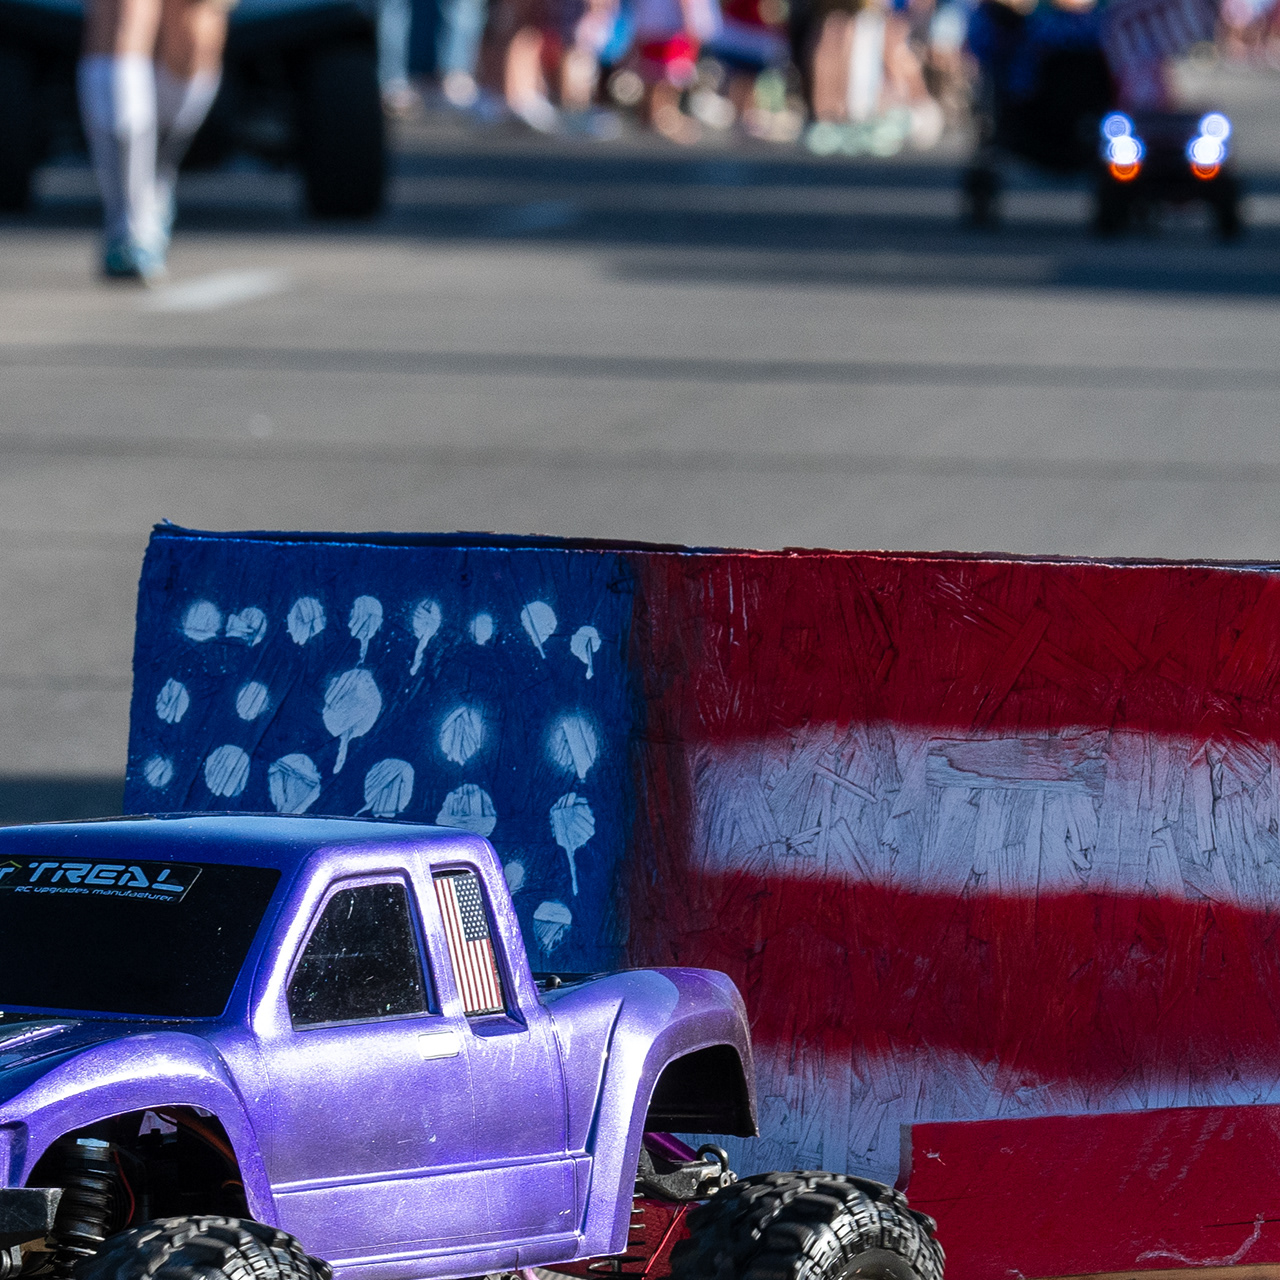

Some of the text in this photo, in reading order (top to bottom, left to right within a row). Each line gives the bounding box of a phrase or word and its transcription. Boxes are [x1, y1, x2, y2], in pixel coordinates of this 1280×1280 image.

[29, 862, 184, 892] TREAL
[14, 885, 174, 902] RC upgrades manufacturer
